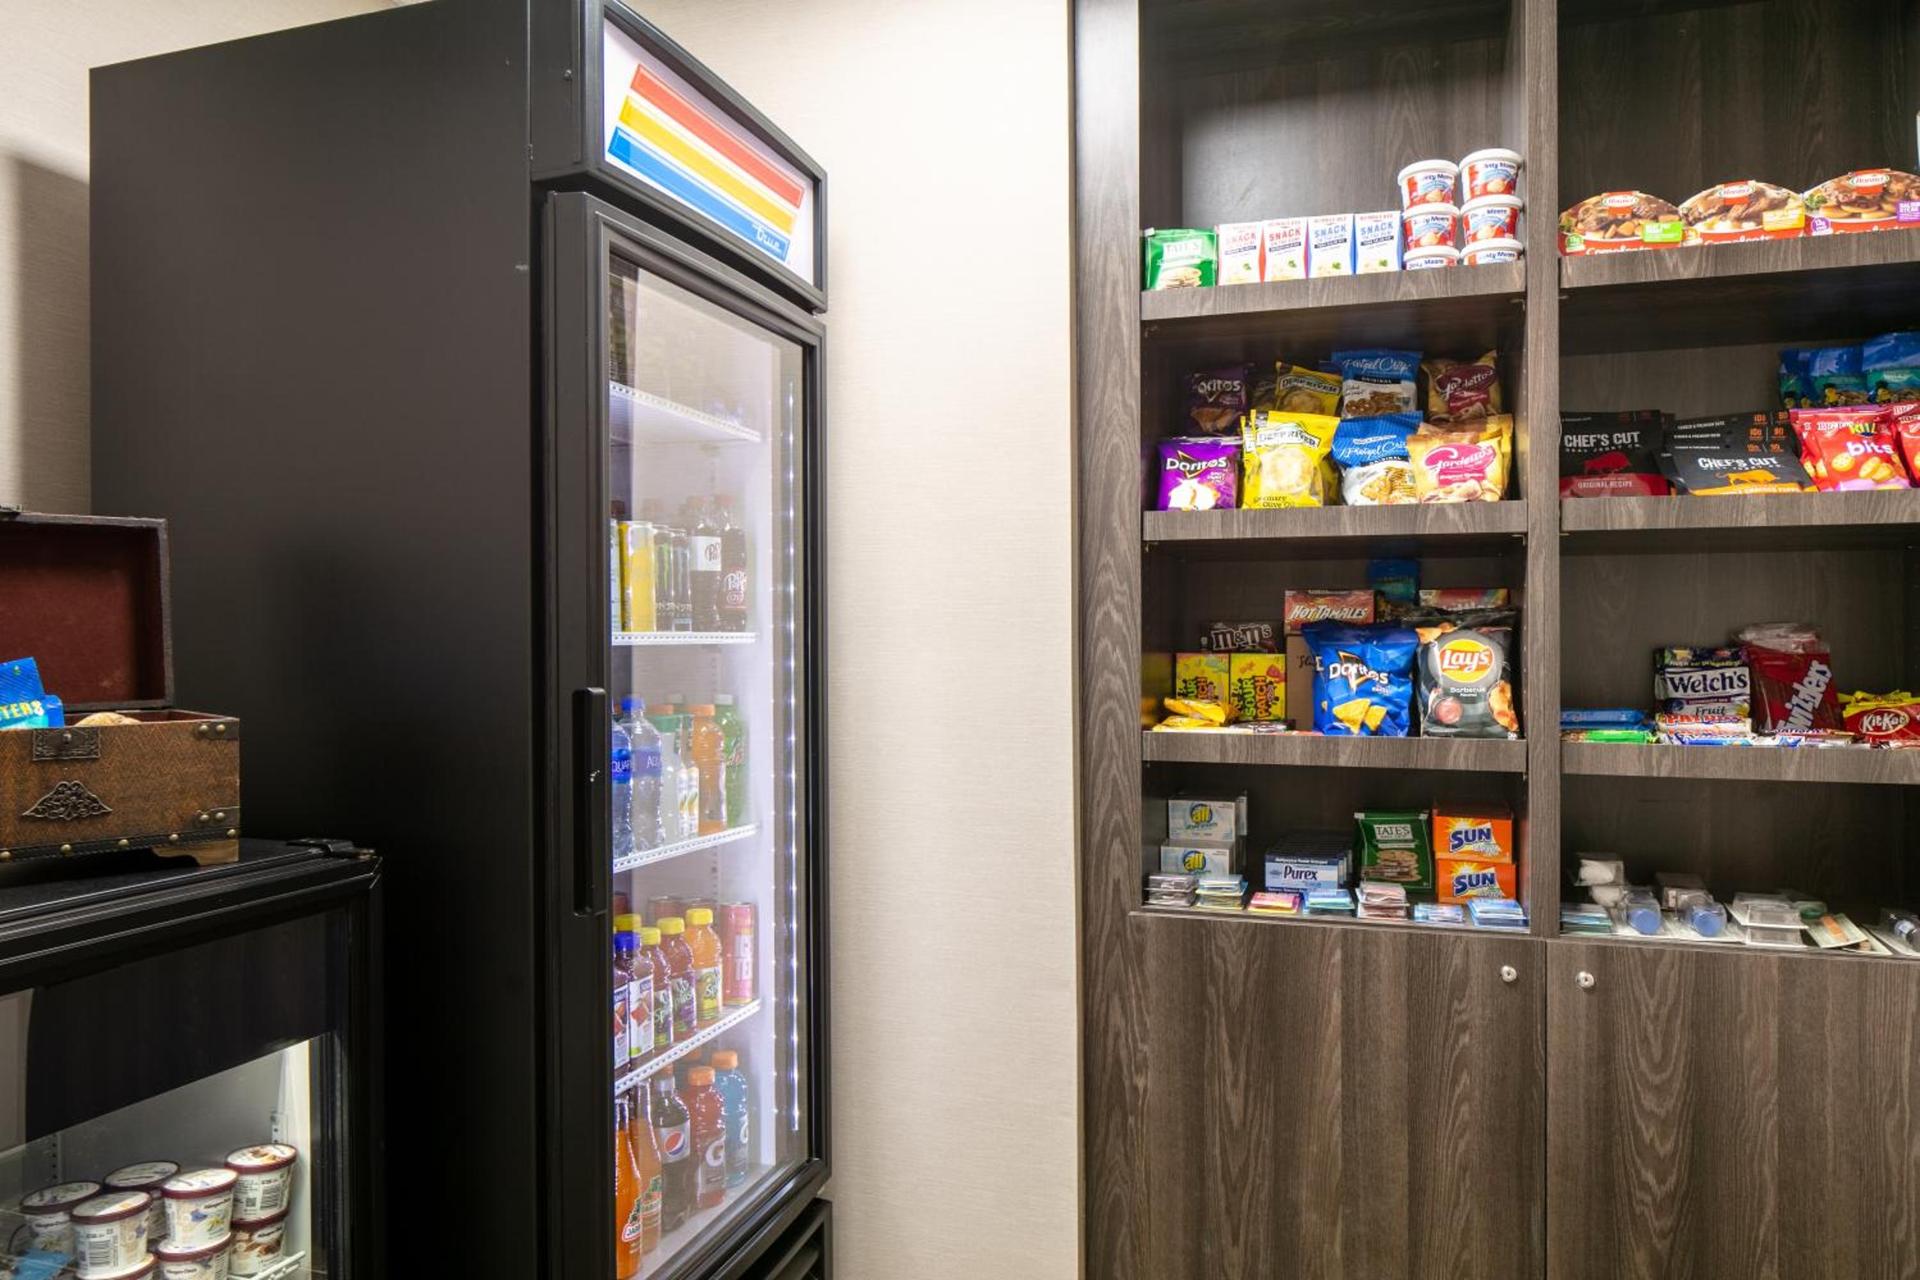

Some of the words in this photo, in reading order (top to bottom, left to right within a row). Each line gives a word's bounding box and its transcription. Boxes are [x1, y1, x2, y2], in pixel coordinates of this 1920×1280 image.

[1268, 228, 1301, 242] SNACK
[1563, 433, 1610, 448] CHEF'S
[1612, 431, 1641, 445] CUT
[1845, 440, 1895, 457] bits
[1165, 457, 1228, 471] Doritos
[1697, 457, 1747, 468] CHEF'S
[1749, 456, 1779, 467] CUT
[1329, 663, 1389, 685] Doritos
[1668, 671, 1748, 694] Welch's
[1243, 678, 1257, 720] SOUR
[1256, 676, 1267, 720] PATCH
[1191, 806, 1211, 824] all
[1450, 827, 1491, 851] SUN
[1184, 852, 1204, 871] all
[1283, 864, 1318, 881] Purex
[1454, 872, 1495, 894] SUN
